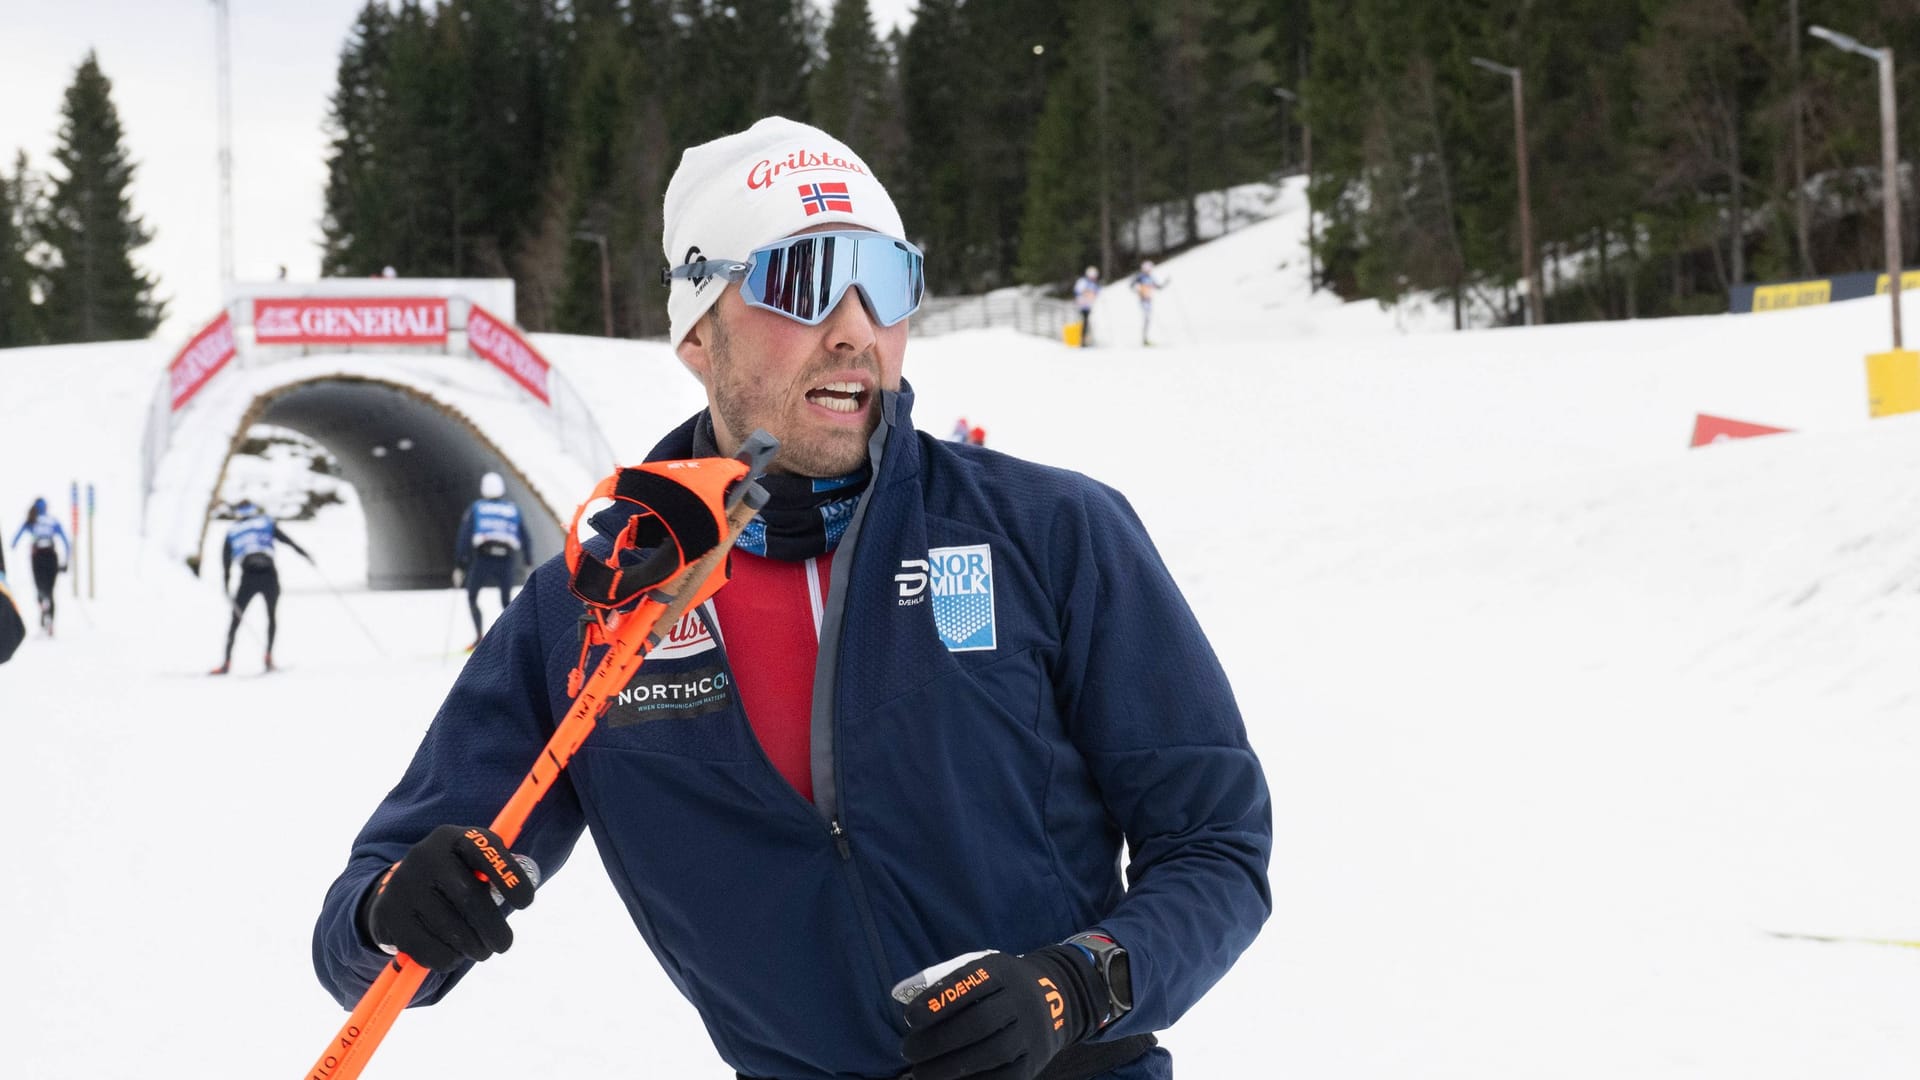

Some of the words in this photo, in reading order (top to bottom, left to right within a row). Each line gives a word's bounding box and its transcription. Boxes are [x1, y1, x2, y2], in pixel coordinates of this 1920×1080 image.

[300, 305, 446, 336] GENERALI
[928, 553, 986, 577] NOR
[929, 573, 989, 597] MILK
[638, 703, 656, 712] WHEN
[656, 699, 703, 710] COMMUNICATION
[703, 692, 726, 703] MATTERS
[340, 1025, 361, 1049] 40
